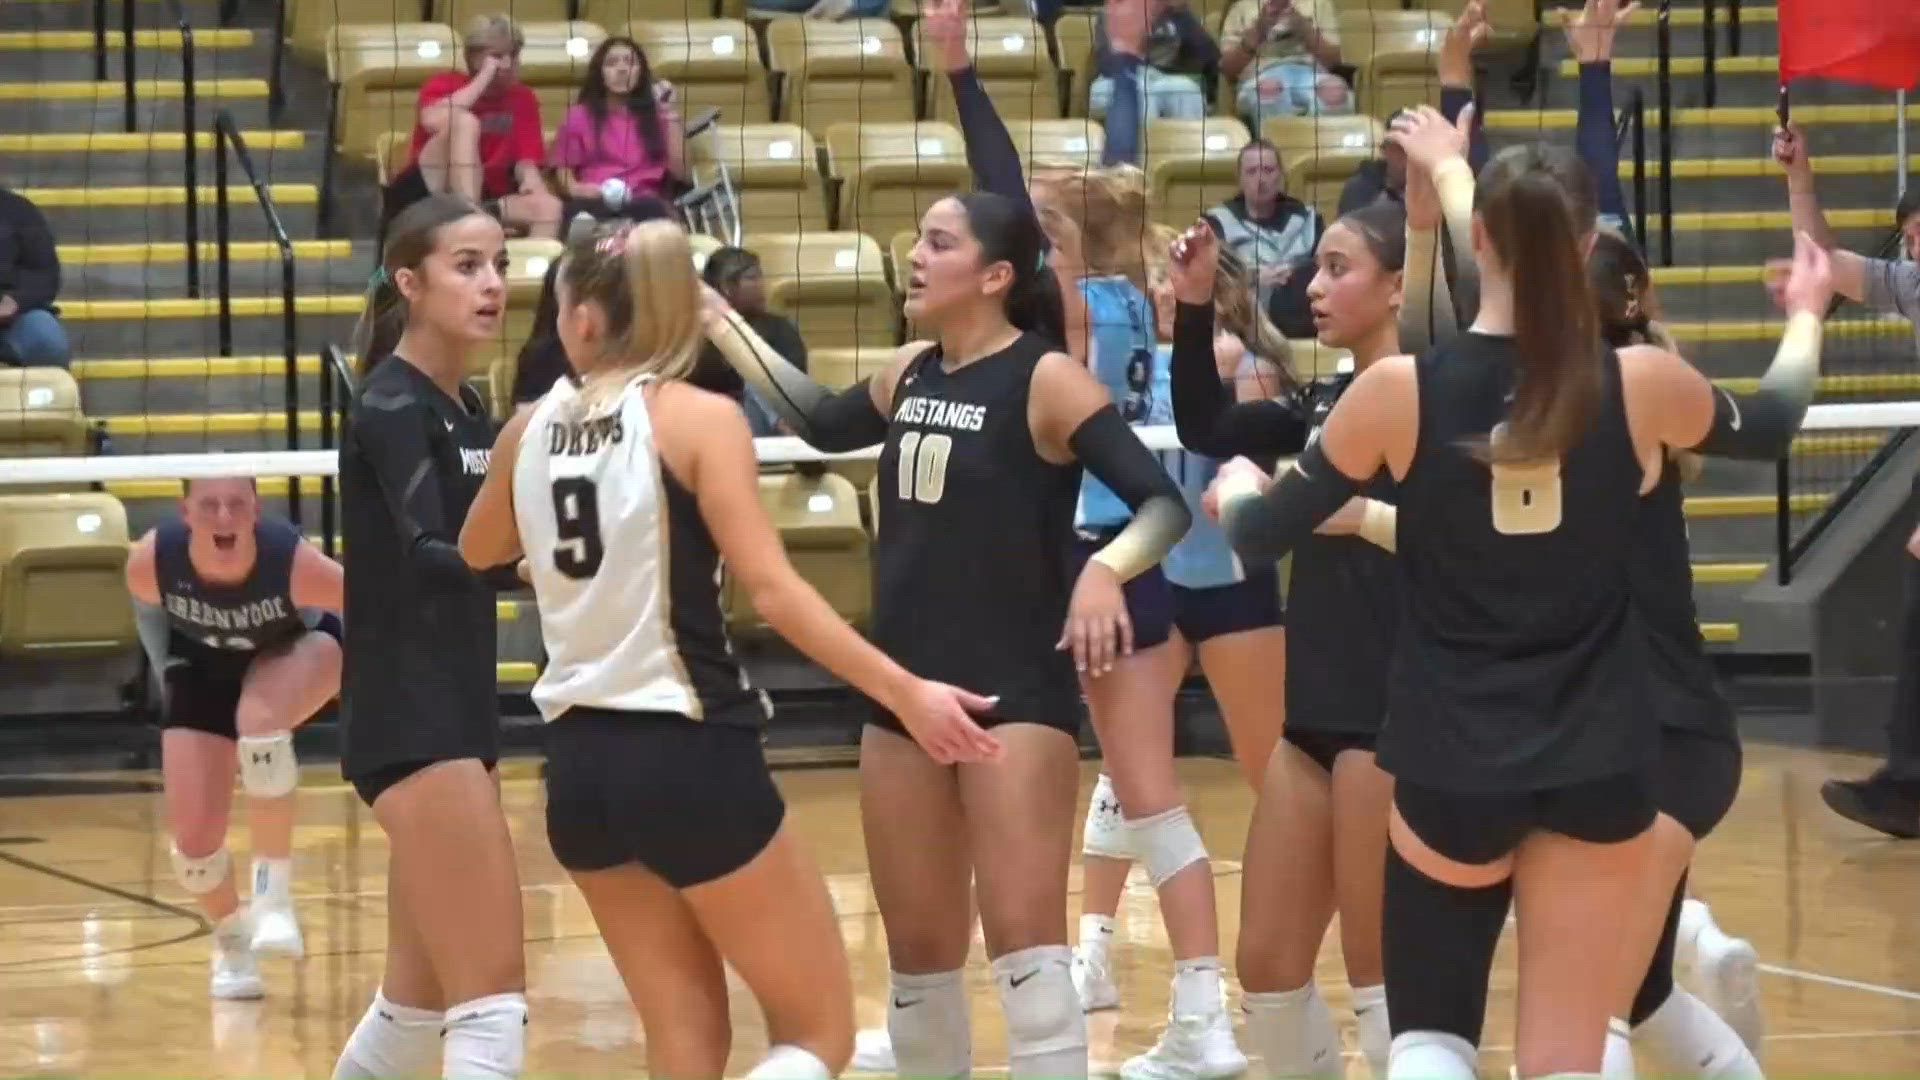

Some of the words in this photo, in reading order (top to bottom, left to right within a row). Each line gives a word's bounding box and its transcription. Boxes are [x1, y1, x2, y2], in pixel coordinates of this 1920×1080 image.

[895, 396, 987, 431] MUSTANGS
[898, 431, 952, 504] 10
[551, 475, 604, 580] 9
